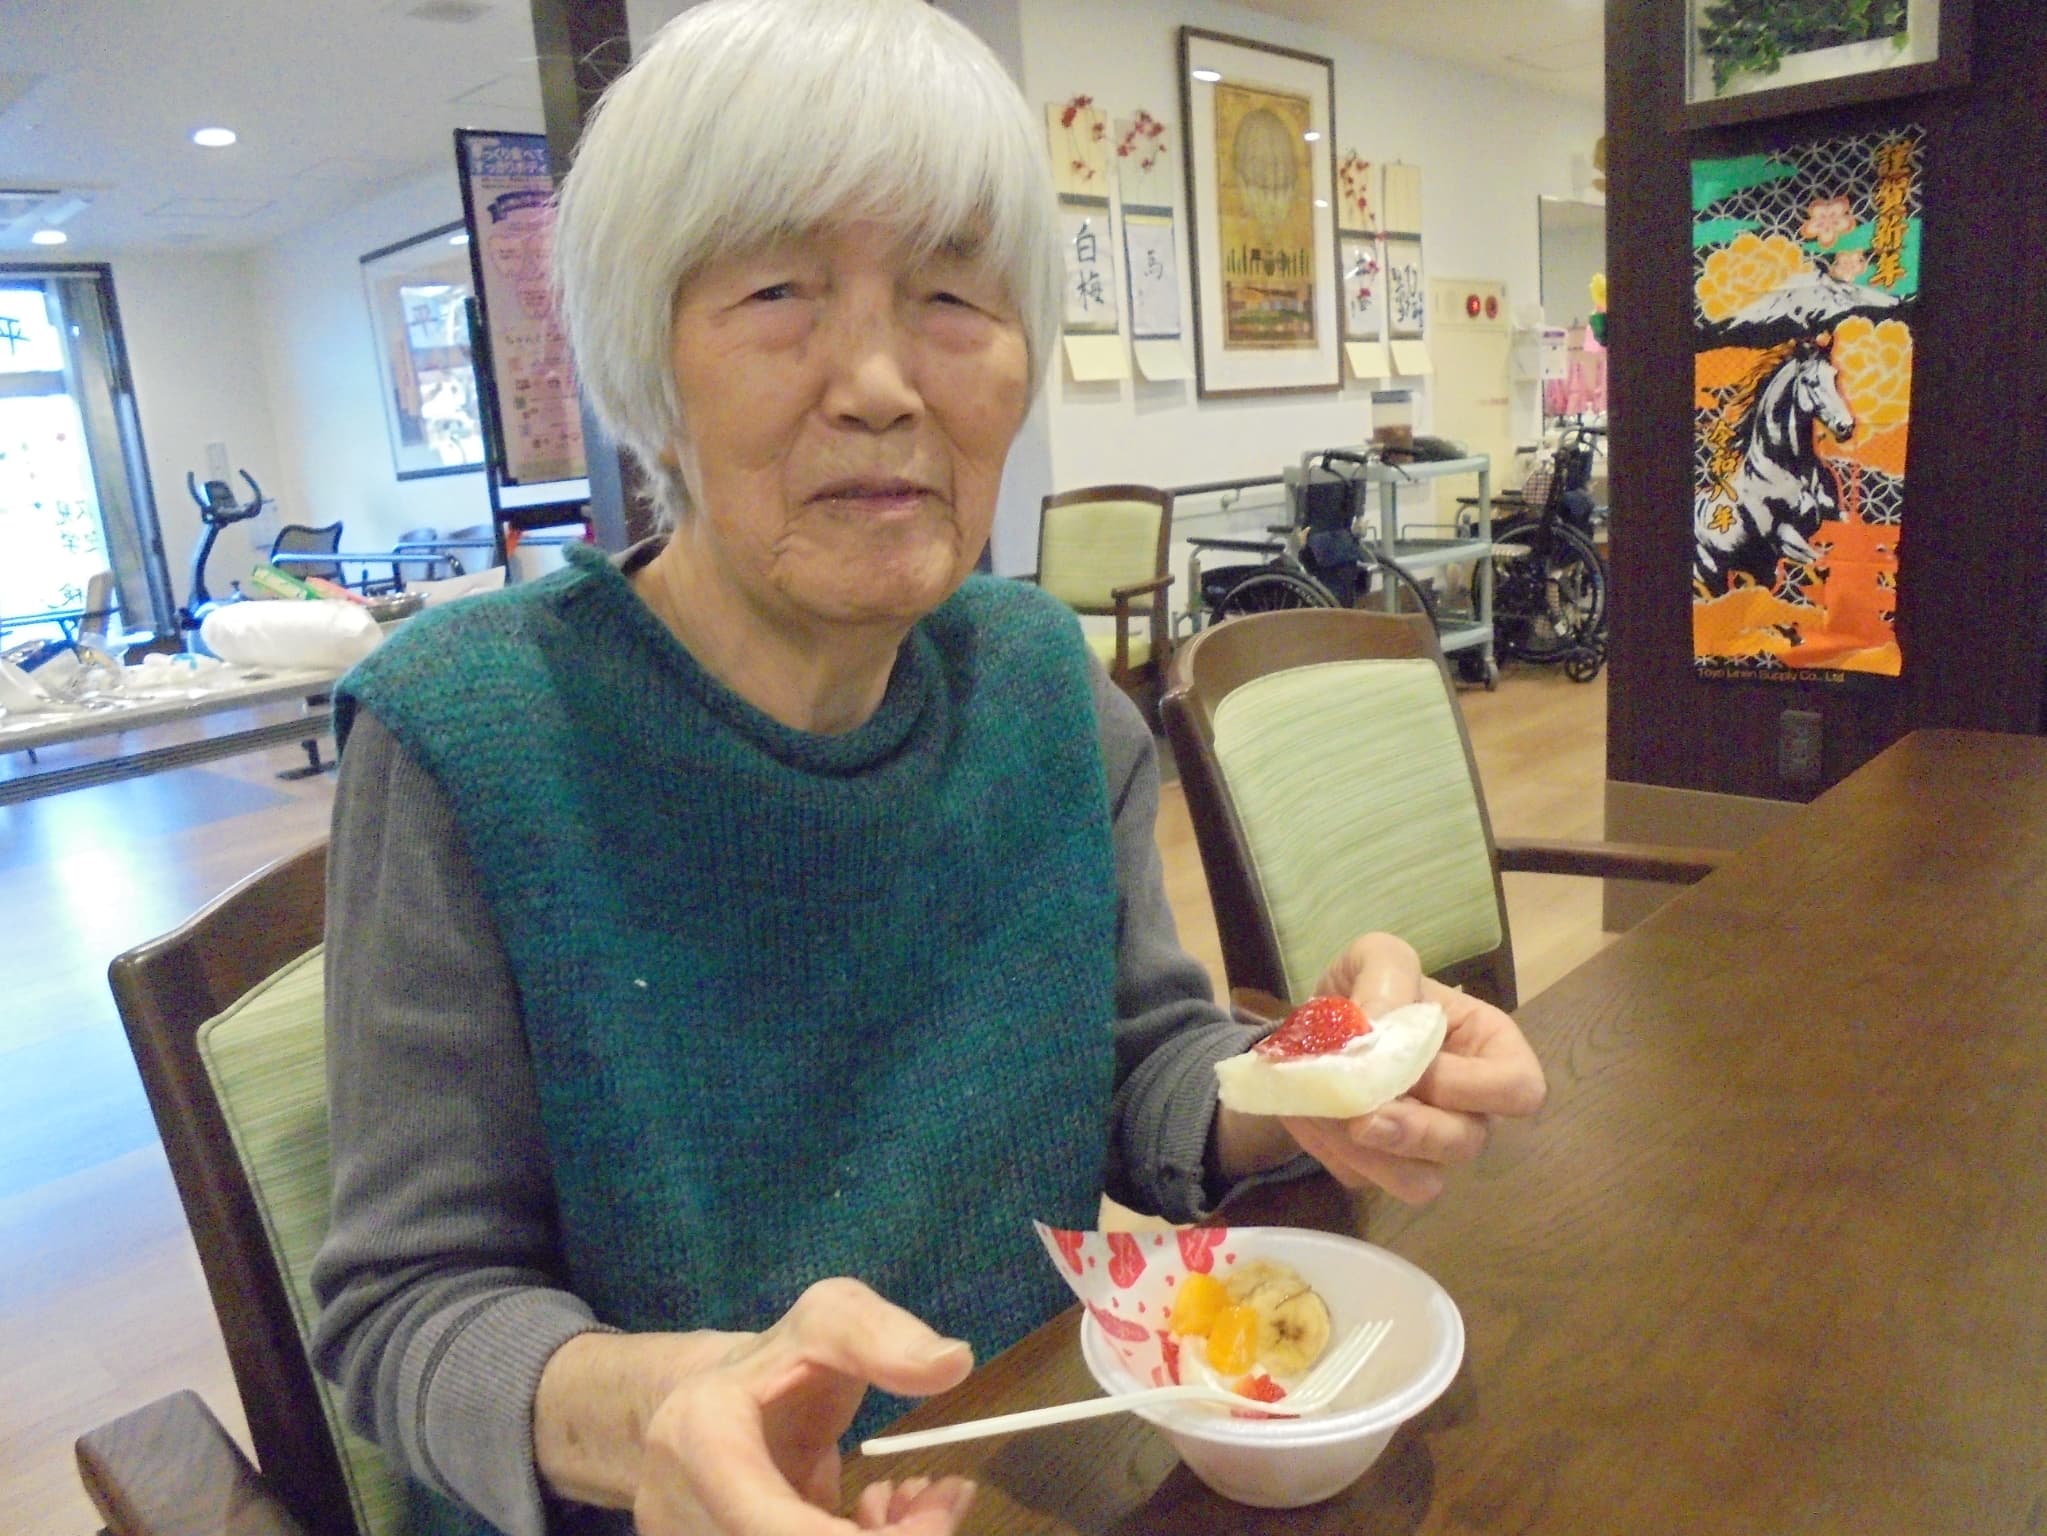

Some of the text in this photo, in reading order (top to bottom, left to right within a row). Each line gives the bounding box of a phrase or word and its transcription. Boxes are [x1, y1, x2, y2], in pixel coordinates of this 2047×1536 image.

[1076, 222, 1104, 311] 白梅
[1869, 139, 1912, 287] 謹賀新年
[1708, 420, 1738, 534] 令和八年
